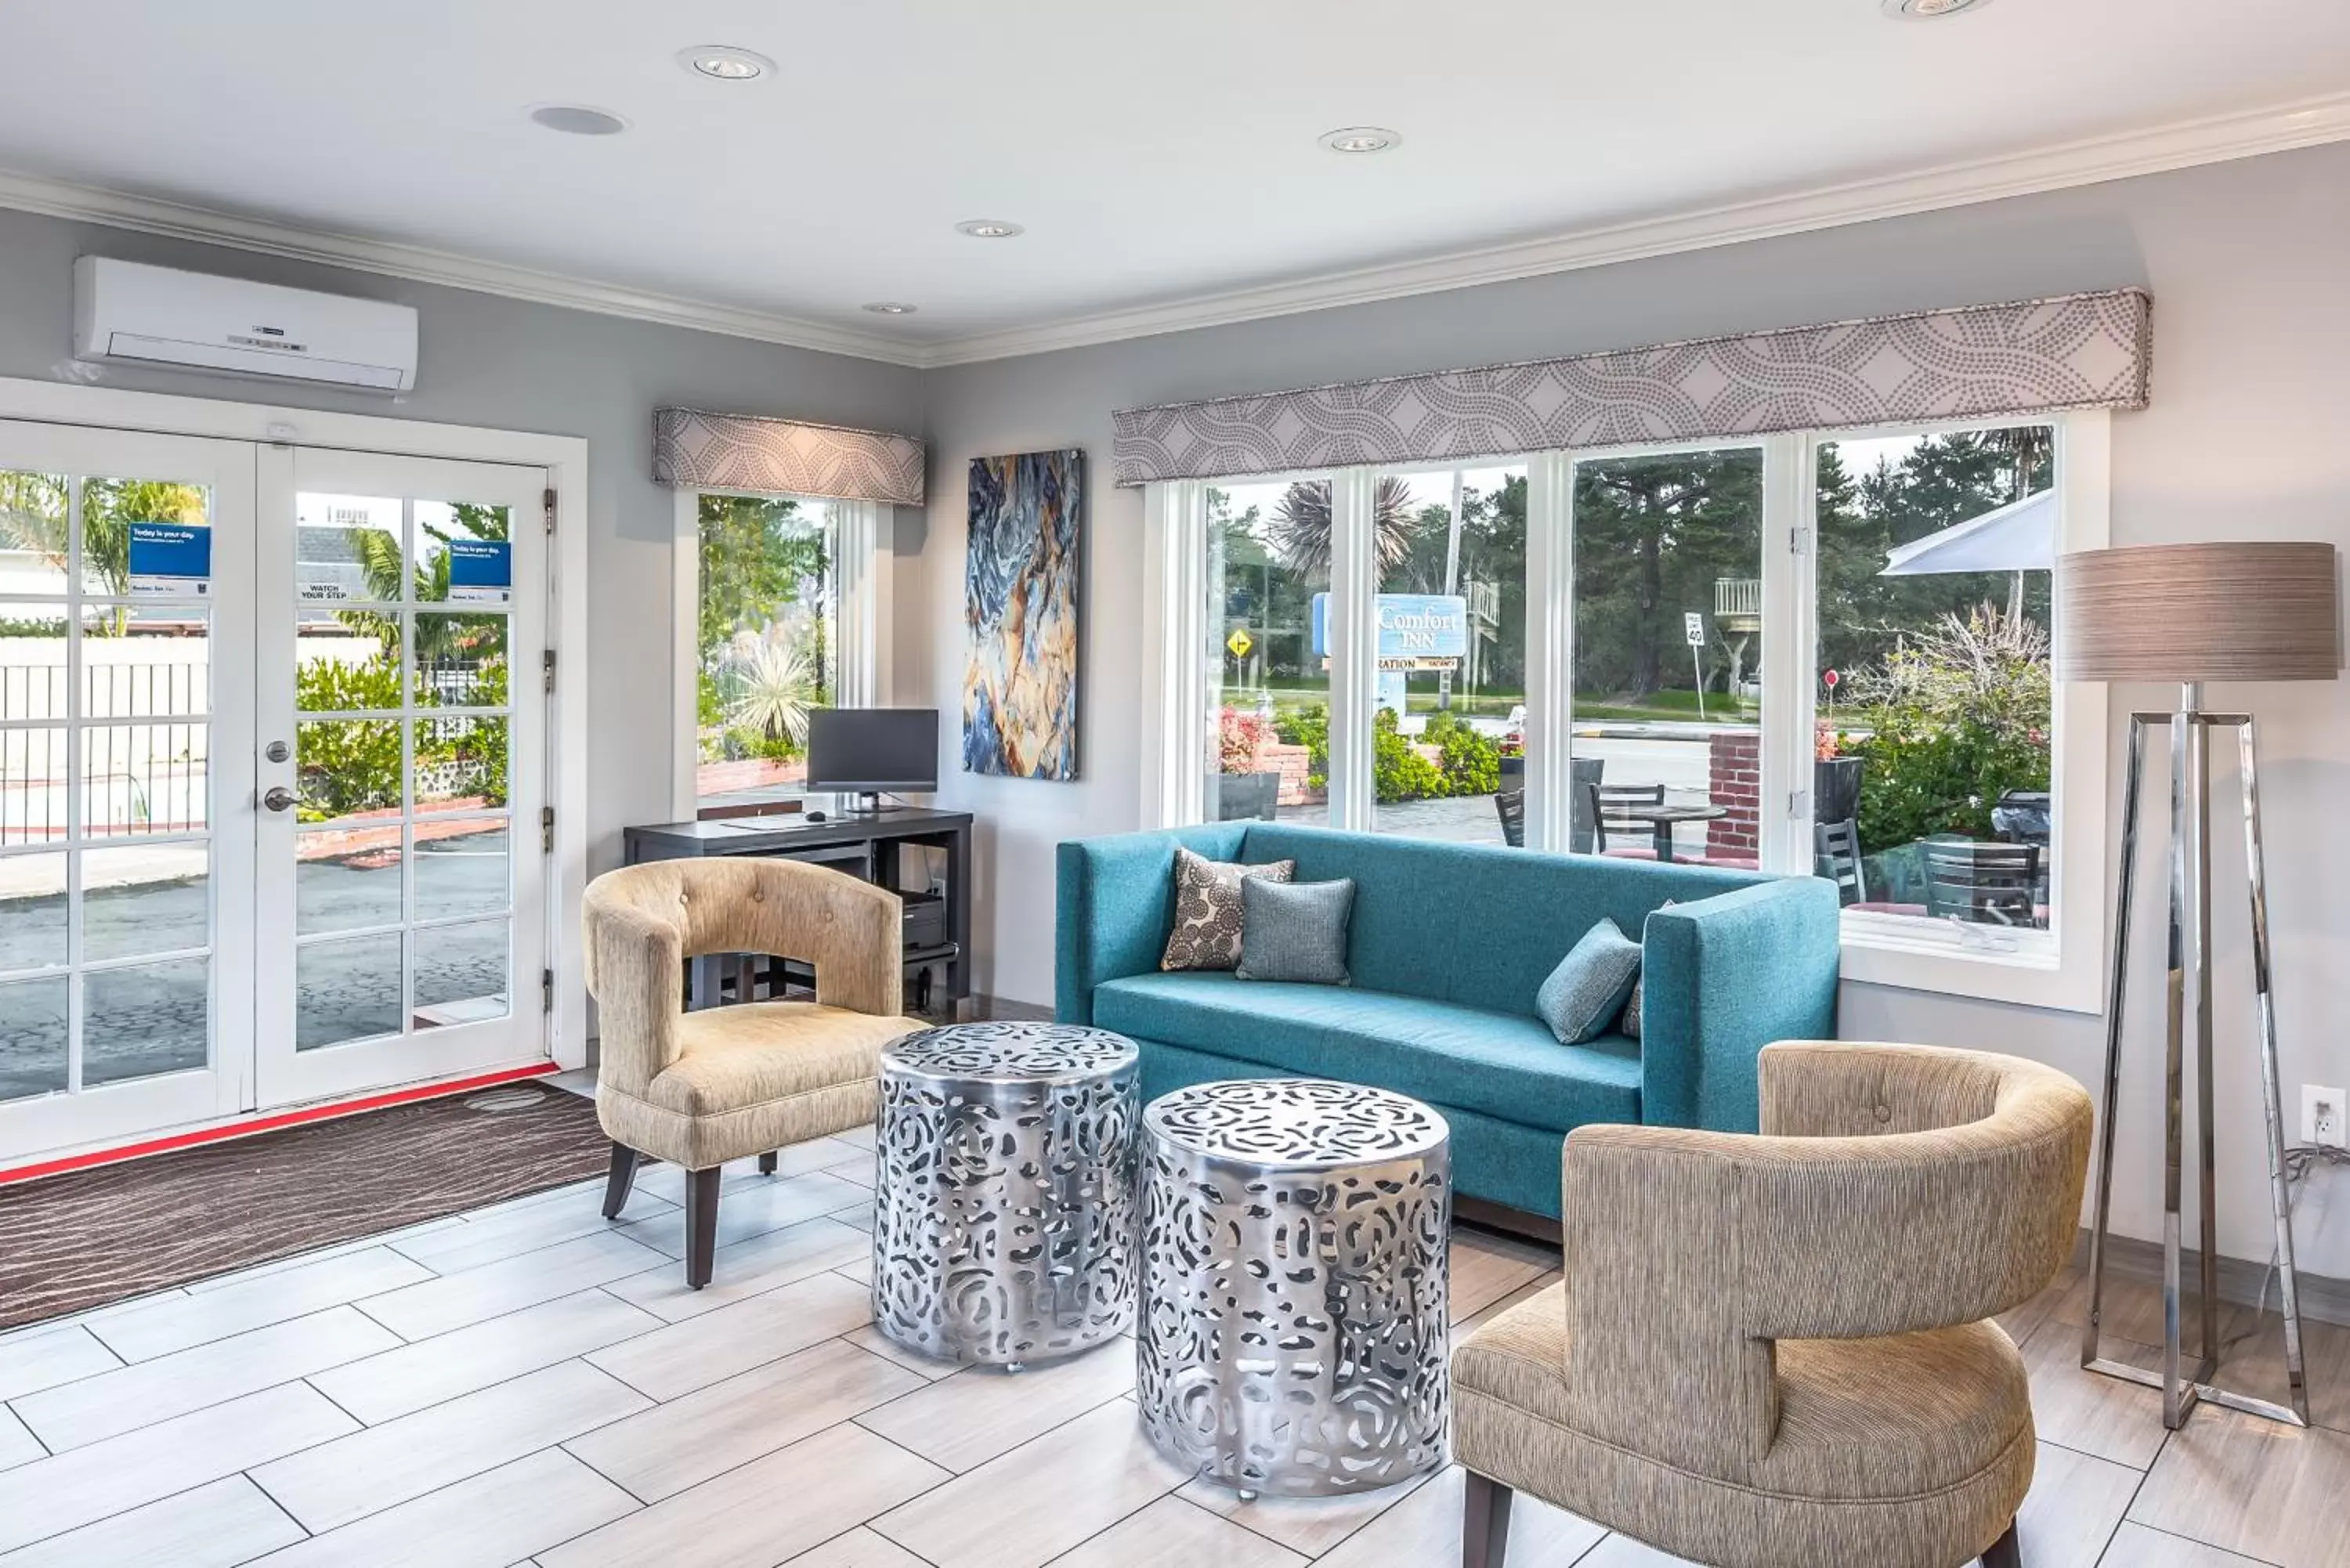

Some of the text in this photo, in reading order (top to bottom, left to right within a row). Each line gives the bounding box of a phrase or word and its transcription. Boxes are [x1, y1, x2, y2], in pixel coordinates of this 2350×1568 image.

[1379, 605, 1455, 630] Comfort
[1401, 631, 1437, 651] INN
[1689, 630, 1702, 641] 40
